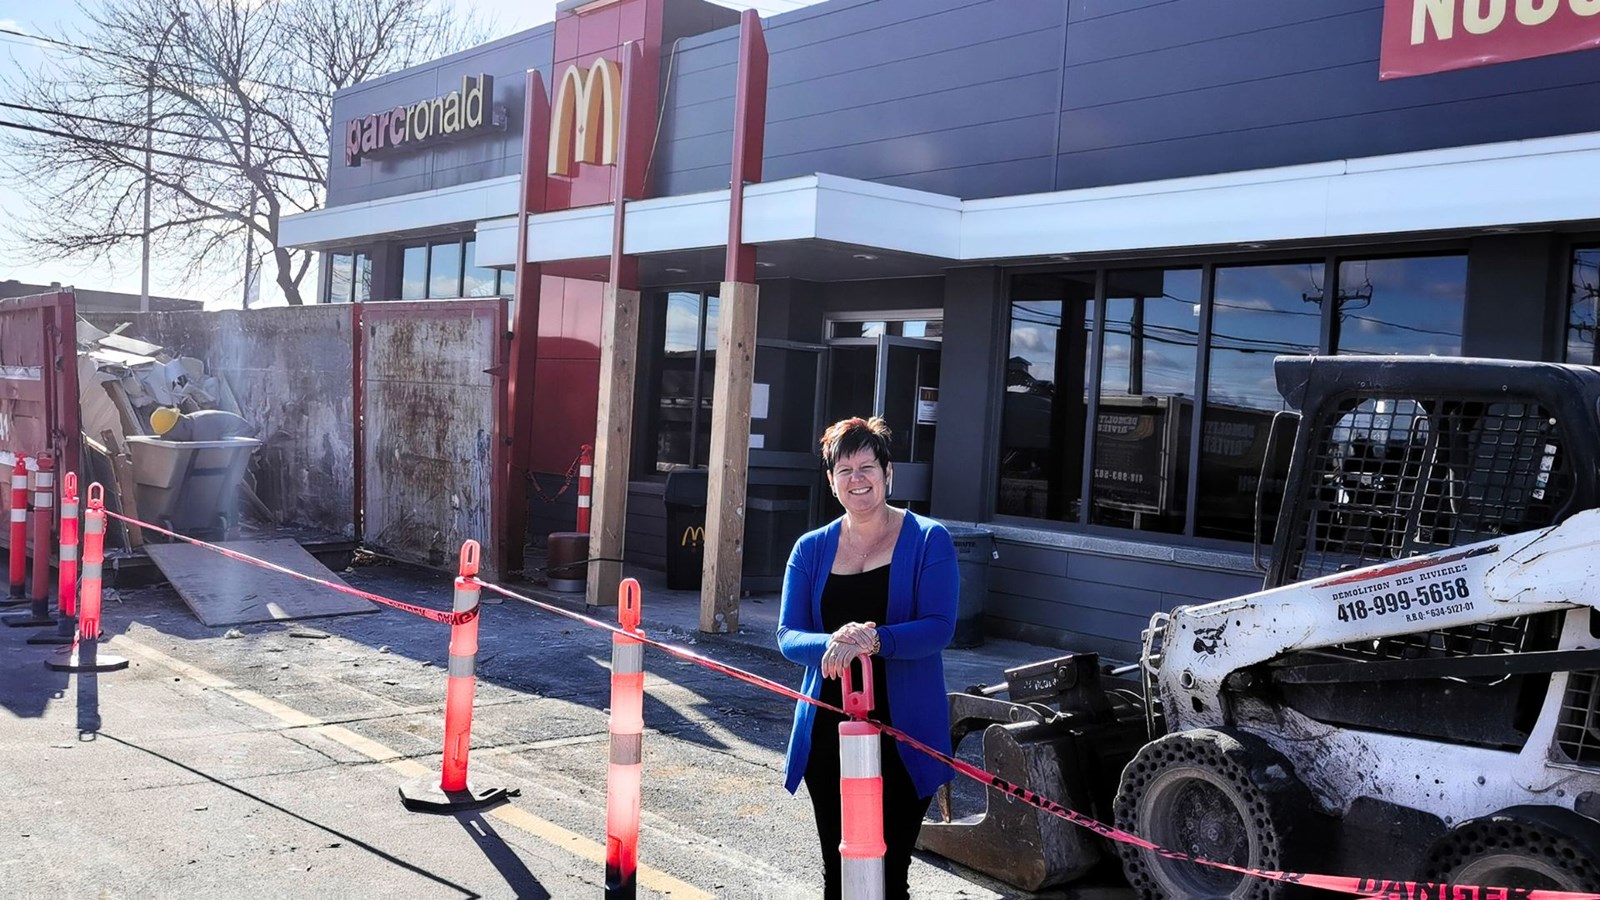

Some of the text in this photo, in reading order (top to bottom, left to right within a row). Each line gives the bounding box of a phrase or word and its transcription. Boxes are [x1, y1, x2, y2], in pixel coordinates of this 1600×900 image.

[346, 73, 486, 167] parcronald
[1332, 564, 1468, 601] DEMOLITION DES RIVIERES
[1337, 577, 1470, 622] 418-999-5658
